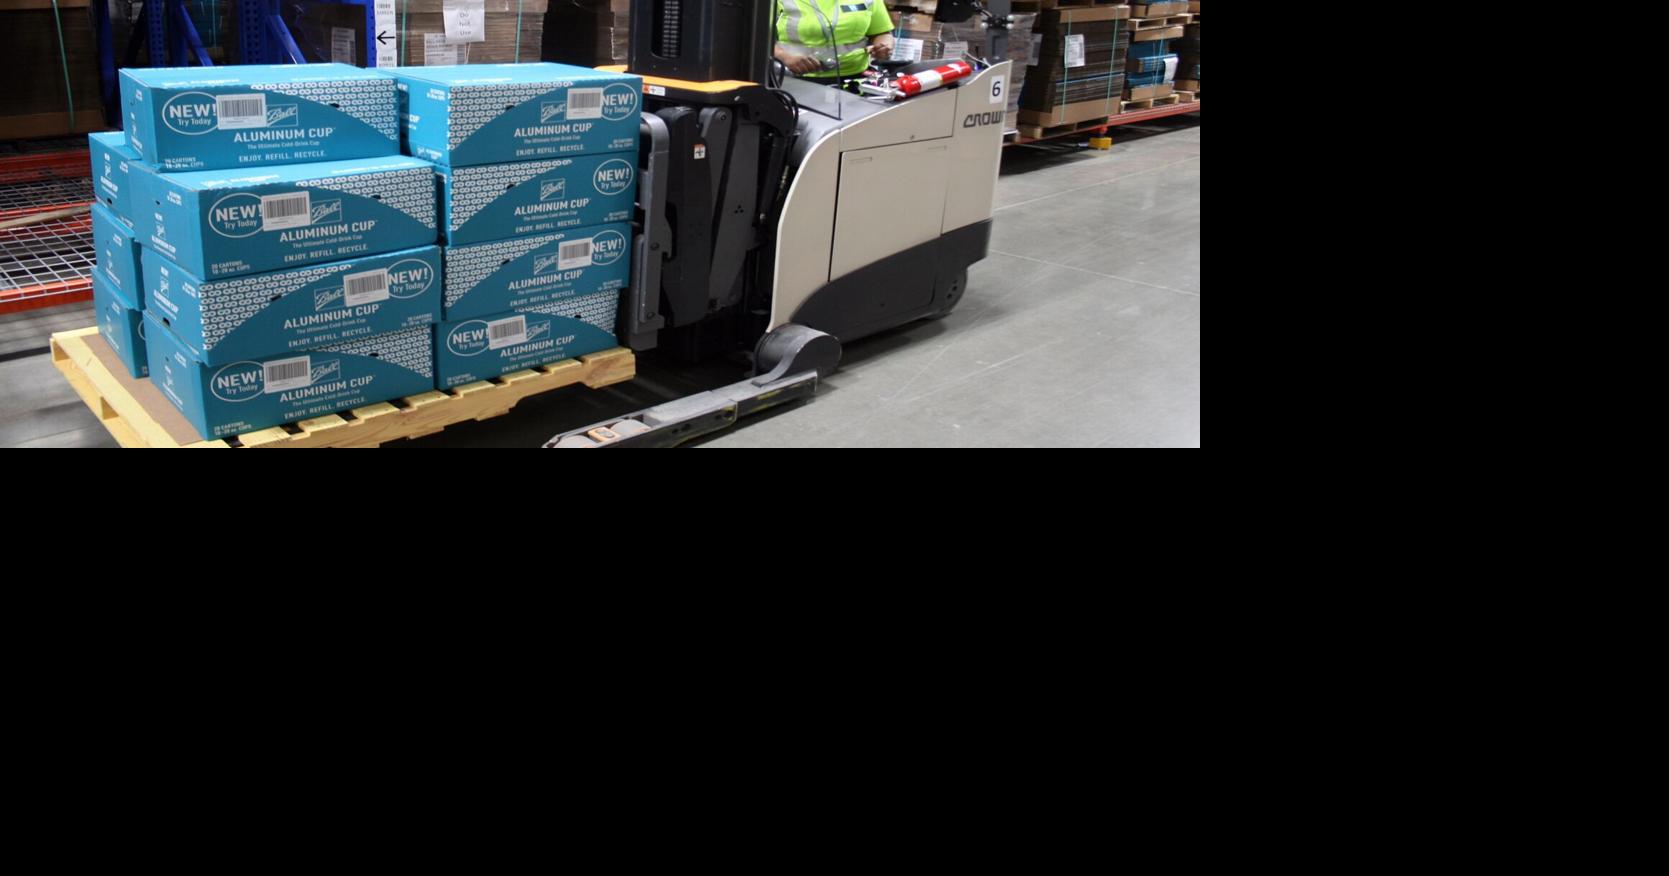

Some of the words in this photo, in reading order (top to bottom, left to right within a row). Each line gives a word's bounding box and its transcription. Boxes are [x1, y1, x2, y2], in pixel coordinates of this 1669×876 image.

[992, 81, 1001, 97] 6
[602, 94, 634, 106] NEW!
[169, 103, 217, 119] NEW!
[604, 107, 613, 115] Try
[614, 106, 630, 114] Today
[178, 118, 191, 127] Try
[191, 118, 212, 126] Today
[234, 128, 305, 143] ALUMINUM
[514, 124, 570, 138] ALUMINUM
[598, 168, 630, 182] NEW!
[601, 182, 610, 190] Try
[610, 180, 626, 188] Today
[215, 204, 263, 222] NEW!
[514, 200, 568, 216] ALUMINUM
[224, 222, 236, 230] Try
[237, 220, 258, 228] Today
[280, 224, 348, 242] ALUMINUM
[592, 238, 622, 253] NEW!
[389, 268, 429, 285] NEW!
[508, 274, 562, 290] ALUMINUM
[393, 286, 403, 294] Try
[406, 282, 425, 292] Today
[284, 308, 352, 330] ALUMINUM
[452, 328, 489, 345] NEW!
[469, 340, 484, 348] Today
[500, 341, 554, 358] ALUMINUM
[218, 370, 264, 389] NEW!
[226, 387, 237, 395] Try
[239, 384, 258, 393] Today
[280, 380, 347, 403] ALUMINUM
